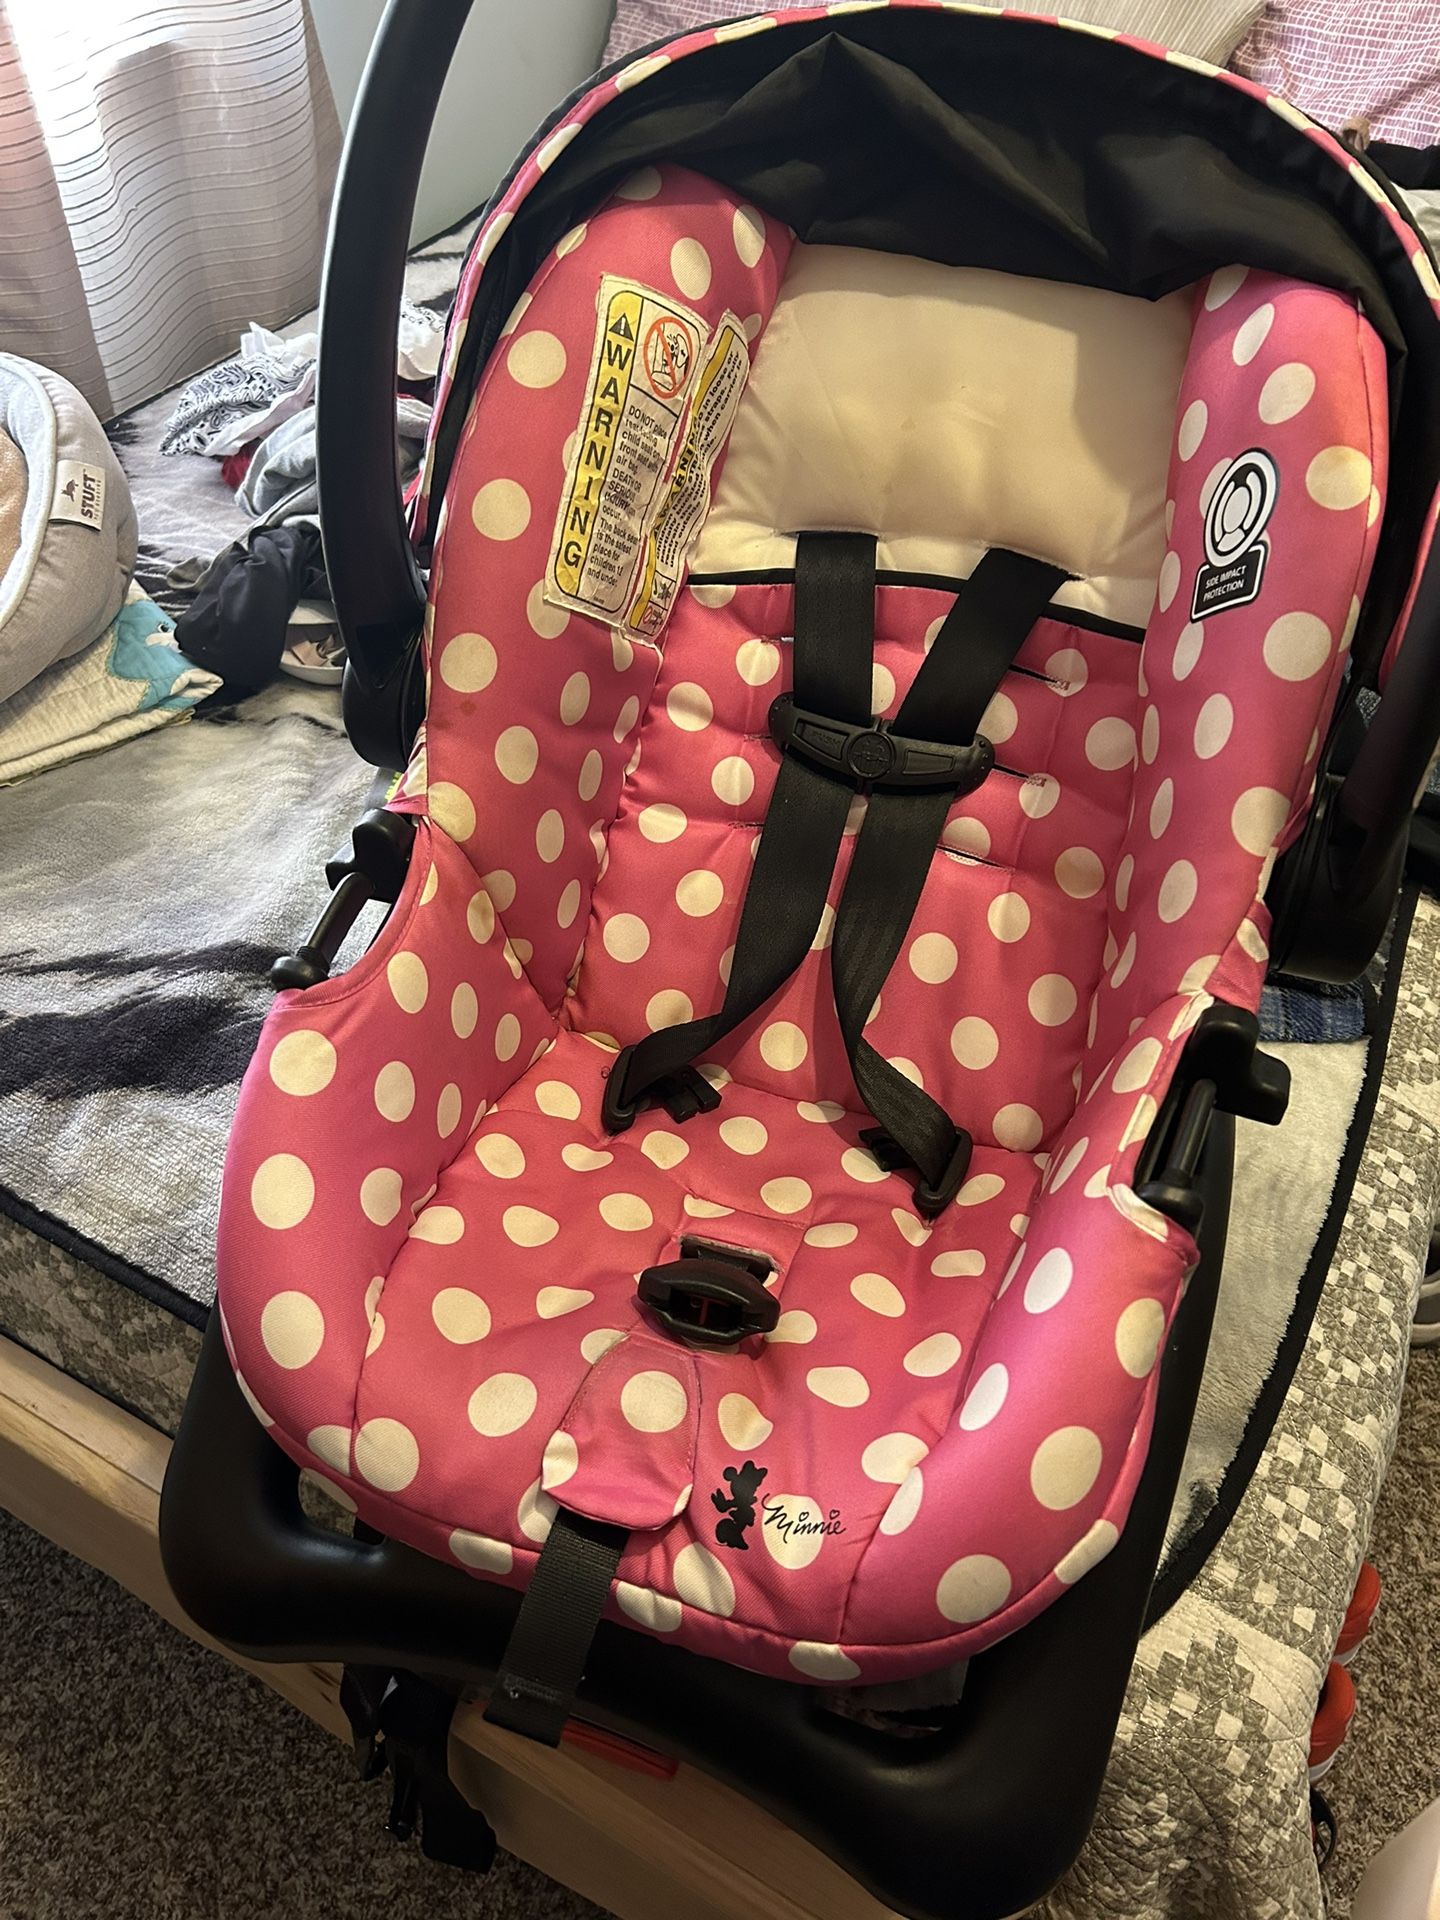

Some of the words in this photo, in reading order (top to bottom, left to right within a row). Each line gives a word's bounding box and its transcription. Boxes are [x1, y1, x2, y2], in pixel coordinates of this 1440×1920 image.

[628, 404, 642, 420] DO
[641, 412, 656, 428] NOT
[653, 423, 668, 439] place
[672, 486, 689, 510] have
[709, 367, 728, 397] loose
[726, 350, 734, 365] or
[676, 473, 700, 515] buckled
[704, 387, 727, 422] straps.
[727, 351, 740, 379] Fully
[619, 441, 638, 458] front
[622, 431, 641, 447] child
[680, 503, 692, 519] the
[692, 473, 704, 502] child
[704, 413, 721, 441] when
[720, 373, 738, 410] carrier
[563, 339, 632, 569] WARNING
[616, 455, 627, 466] air
[81, 473, 96, 519] STUFT
[600, 517, 613, 531] The
[613, 523, 627, 539] back
[679, 501, 701, 538] outside
[593, 543, 611, 558] place
[611, 550, 620, 562] for
[596, 529, 603, 541] is
[604, 533, 615, 547] the
[615, 540, 632, 555] safest
[587, 566, 601, 579] and
[590, 554, 617, 572] children
[1205, 575, 1220, 589] SIDE
[1219, 564, 1247, 582] IMPACT
[1203, 579, 1245, 602] PROTECTION
[761, 1492, 847, 1544] Minnie
